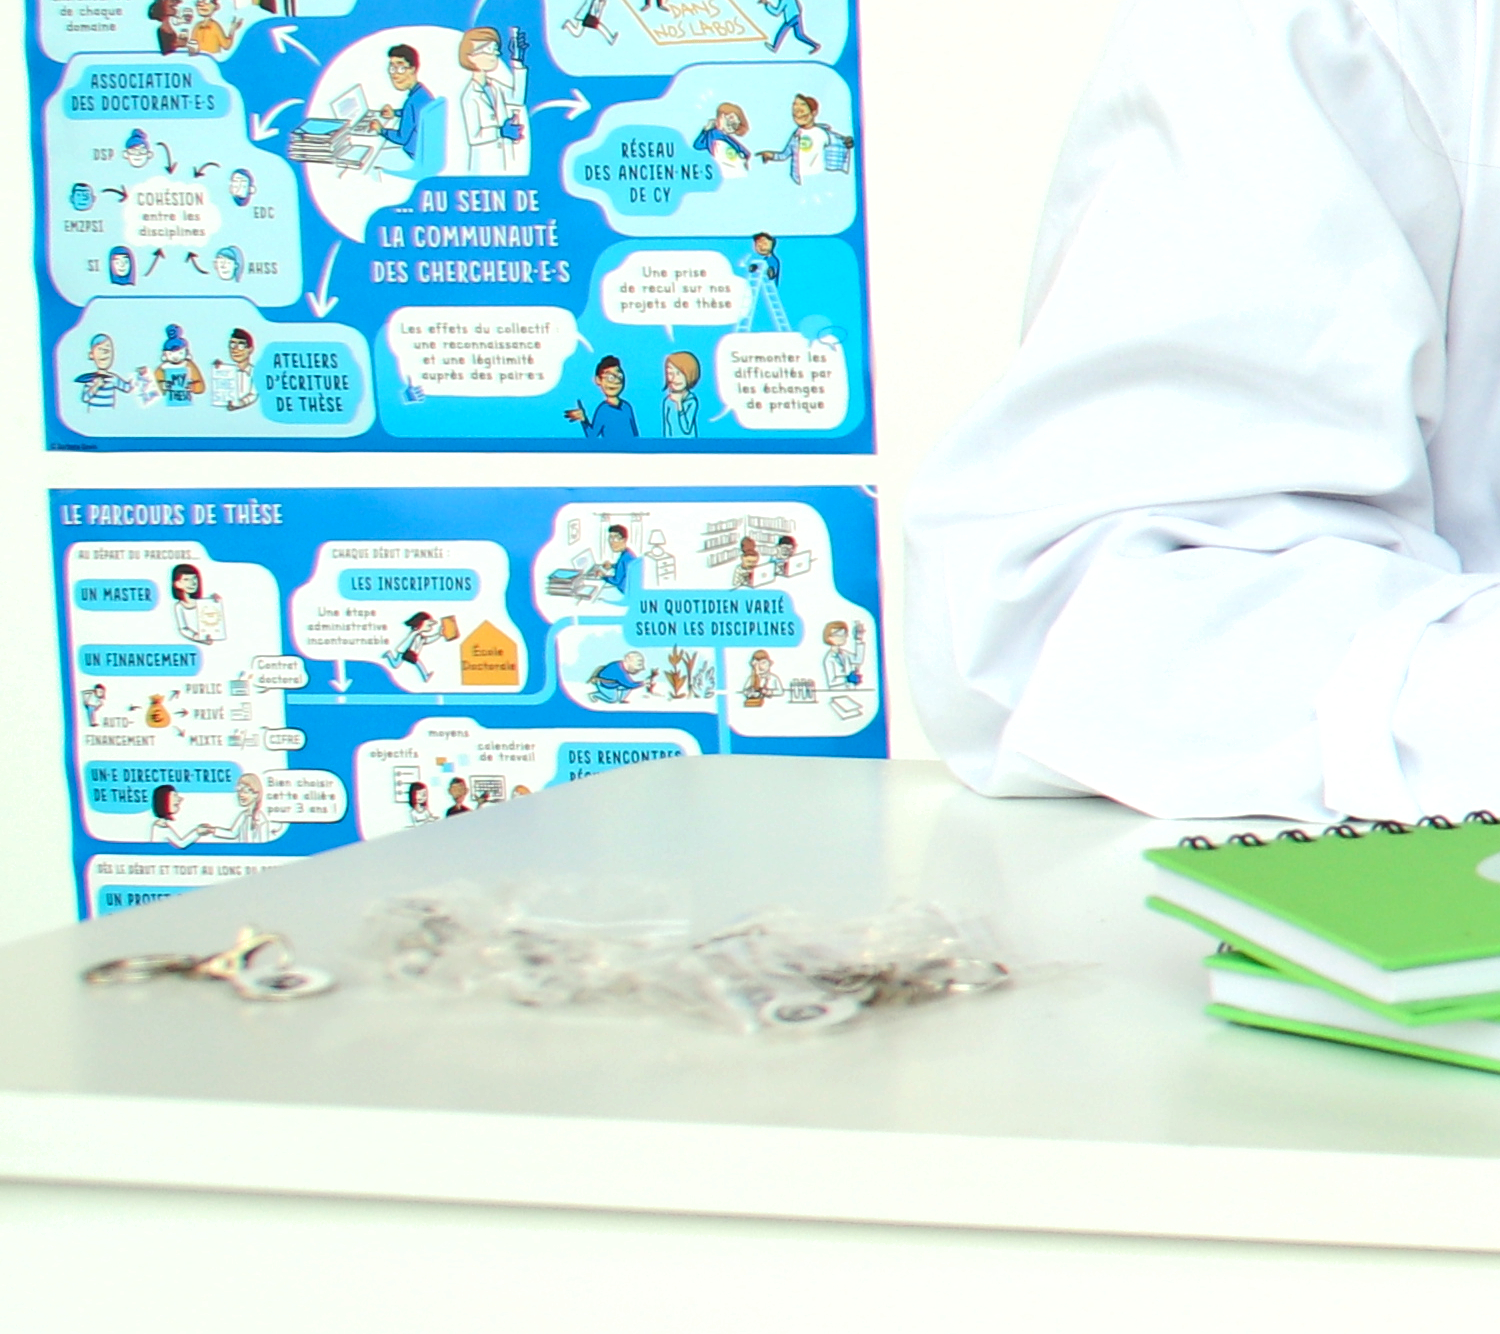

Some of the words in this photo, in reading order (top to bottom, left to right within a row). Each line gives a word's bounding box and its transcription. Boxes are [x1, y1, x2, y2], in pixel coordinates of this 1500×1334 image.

[91, 72, 192, 89] ASSOCIATION
[72, 96, 94, 111] DES
[93, 149, 114, 160] DSP
[621, 139, 674, 158] RÉSEAU
[585, 165, 611, 181] DES
[137, 189, 204, 206] COHÉSION
[422, 190, 448, 213] AU
[457, 190, 506, 213] SEIN
[515, 190, 540, 212] DE
[630, 187, 647, 203] DE
[654, 187, 671, 203] CY
[254, 207, 275, 219] EDC
[380, 226, 405, 248] LA
[413, 219, 558, 248] COMMUNAUTÉ
[372, 261, 409, 283] DES
[642, 267, 668, 278] Une
[675, 267, 707, 282] prise
[620, 283, 635, 294] de
[642, 282, 675, 294] recul
[683, 284, 702, 294] sur
[710, 284, 731, 294] nos
[620, 298, 667, 313] projets
[673, 298, 689, 309] de
[696, 297, 732, 309] thèse
[401, 324, 422, 334] Les
[429, 323, 468, 334] effets
[474, 323, 490, 334] du
[497, 323, 551, 334] collectif
[273, 352, 338, 370] ATELIERS
[731, 351, 801, 363] Surmonter
[808, 352, 827, 363] les
[734, 367, 804, 379] difficultés
[811, 369, 832, 381] par
[738, 383, 756, 394] les
[764, 384, 825, 398] échanges
[276, 396, 294, 413] DE
[302, 392, 344, 413] THÈSE
[747, 399, 762, 410] de
[769, 399, 825, 414] pratique
[62, 504, 82, 526] LE
[87, 504, 185, 526] PARCOURS
[192, 504, 217, 525] DE
[223, 498, 283, 525] THÈSE
[351, 577, 372, 590] LES
[378, 577, 472, 591] INSCRIPTIONS
[82, 588, 98, 601] UN
[103, 587, 152, 602] MASTER
[640, 599, 658, 613] UN
[664, 598, 738, 615] QUOTIDIEN
[745, 597, 784, 613] VARIÉ
[636, 621, 677, 636] SELON
[684, 621, 704, 636] LES
[711, 621, 795, 635] DISCIPLINES
[85, 653, 100, 667] UN
[106, 652, 197, 667] FINANCEMENT
[185, 683, 223, 695] PUBLIC
[194, 707, 225, 720] PRIVÉ
[189, 735, 223, 746] MIXTE
[93, 789, 107, 802] DE
[111, 786, 148, 803] THÈSE
